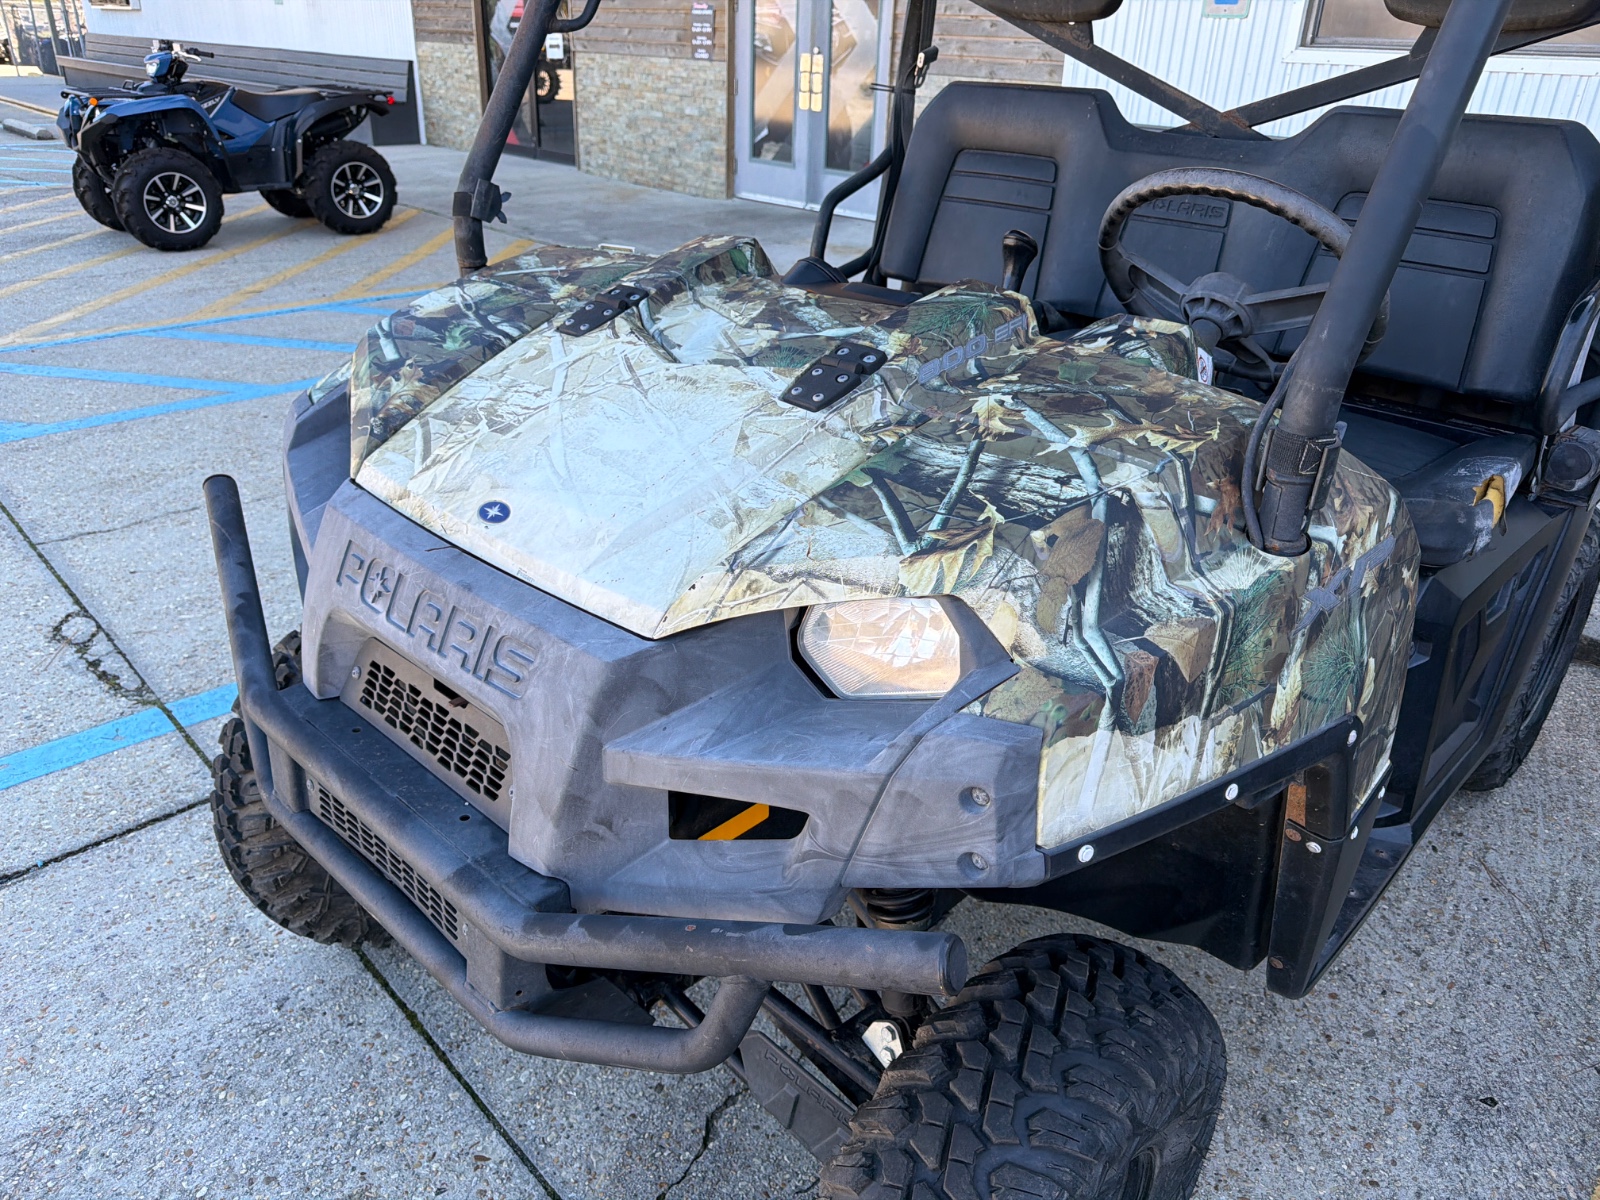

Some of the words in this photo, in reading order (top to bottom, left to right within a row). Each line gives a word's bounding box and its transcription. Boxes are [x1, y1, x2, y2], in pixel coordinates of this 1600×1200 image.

[1149, 199, 1226, 219] OLARIS
[994, 312, 1027, 343] EFI
[336, 539, 541, 699] POLARIS
